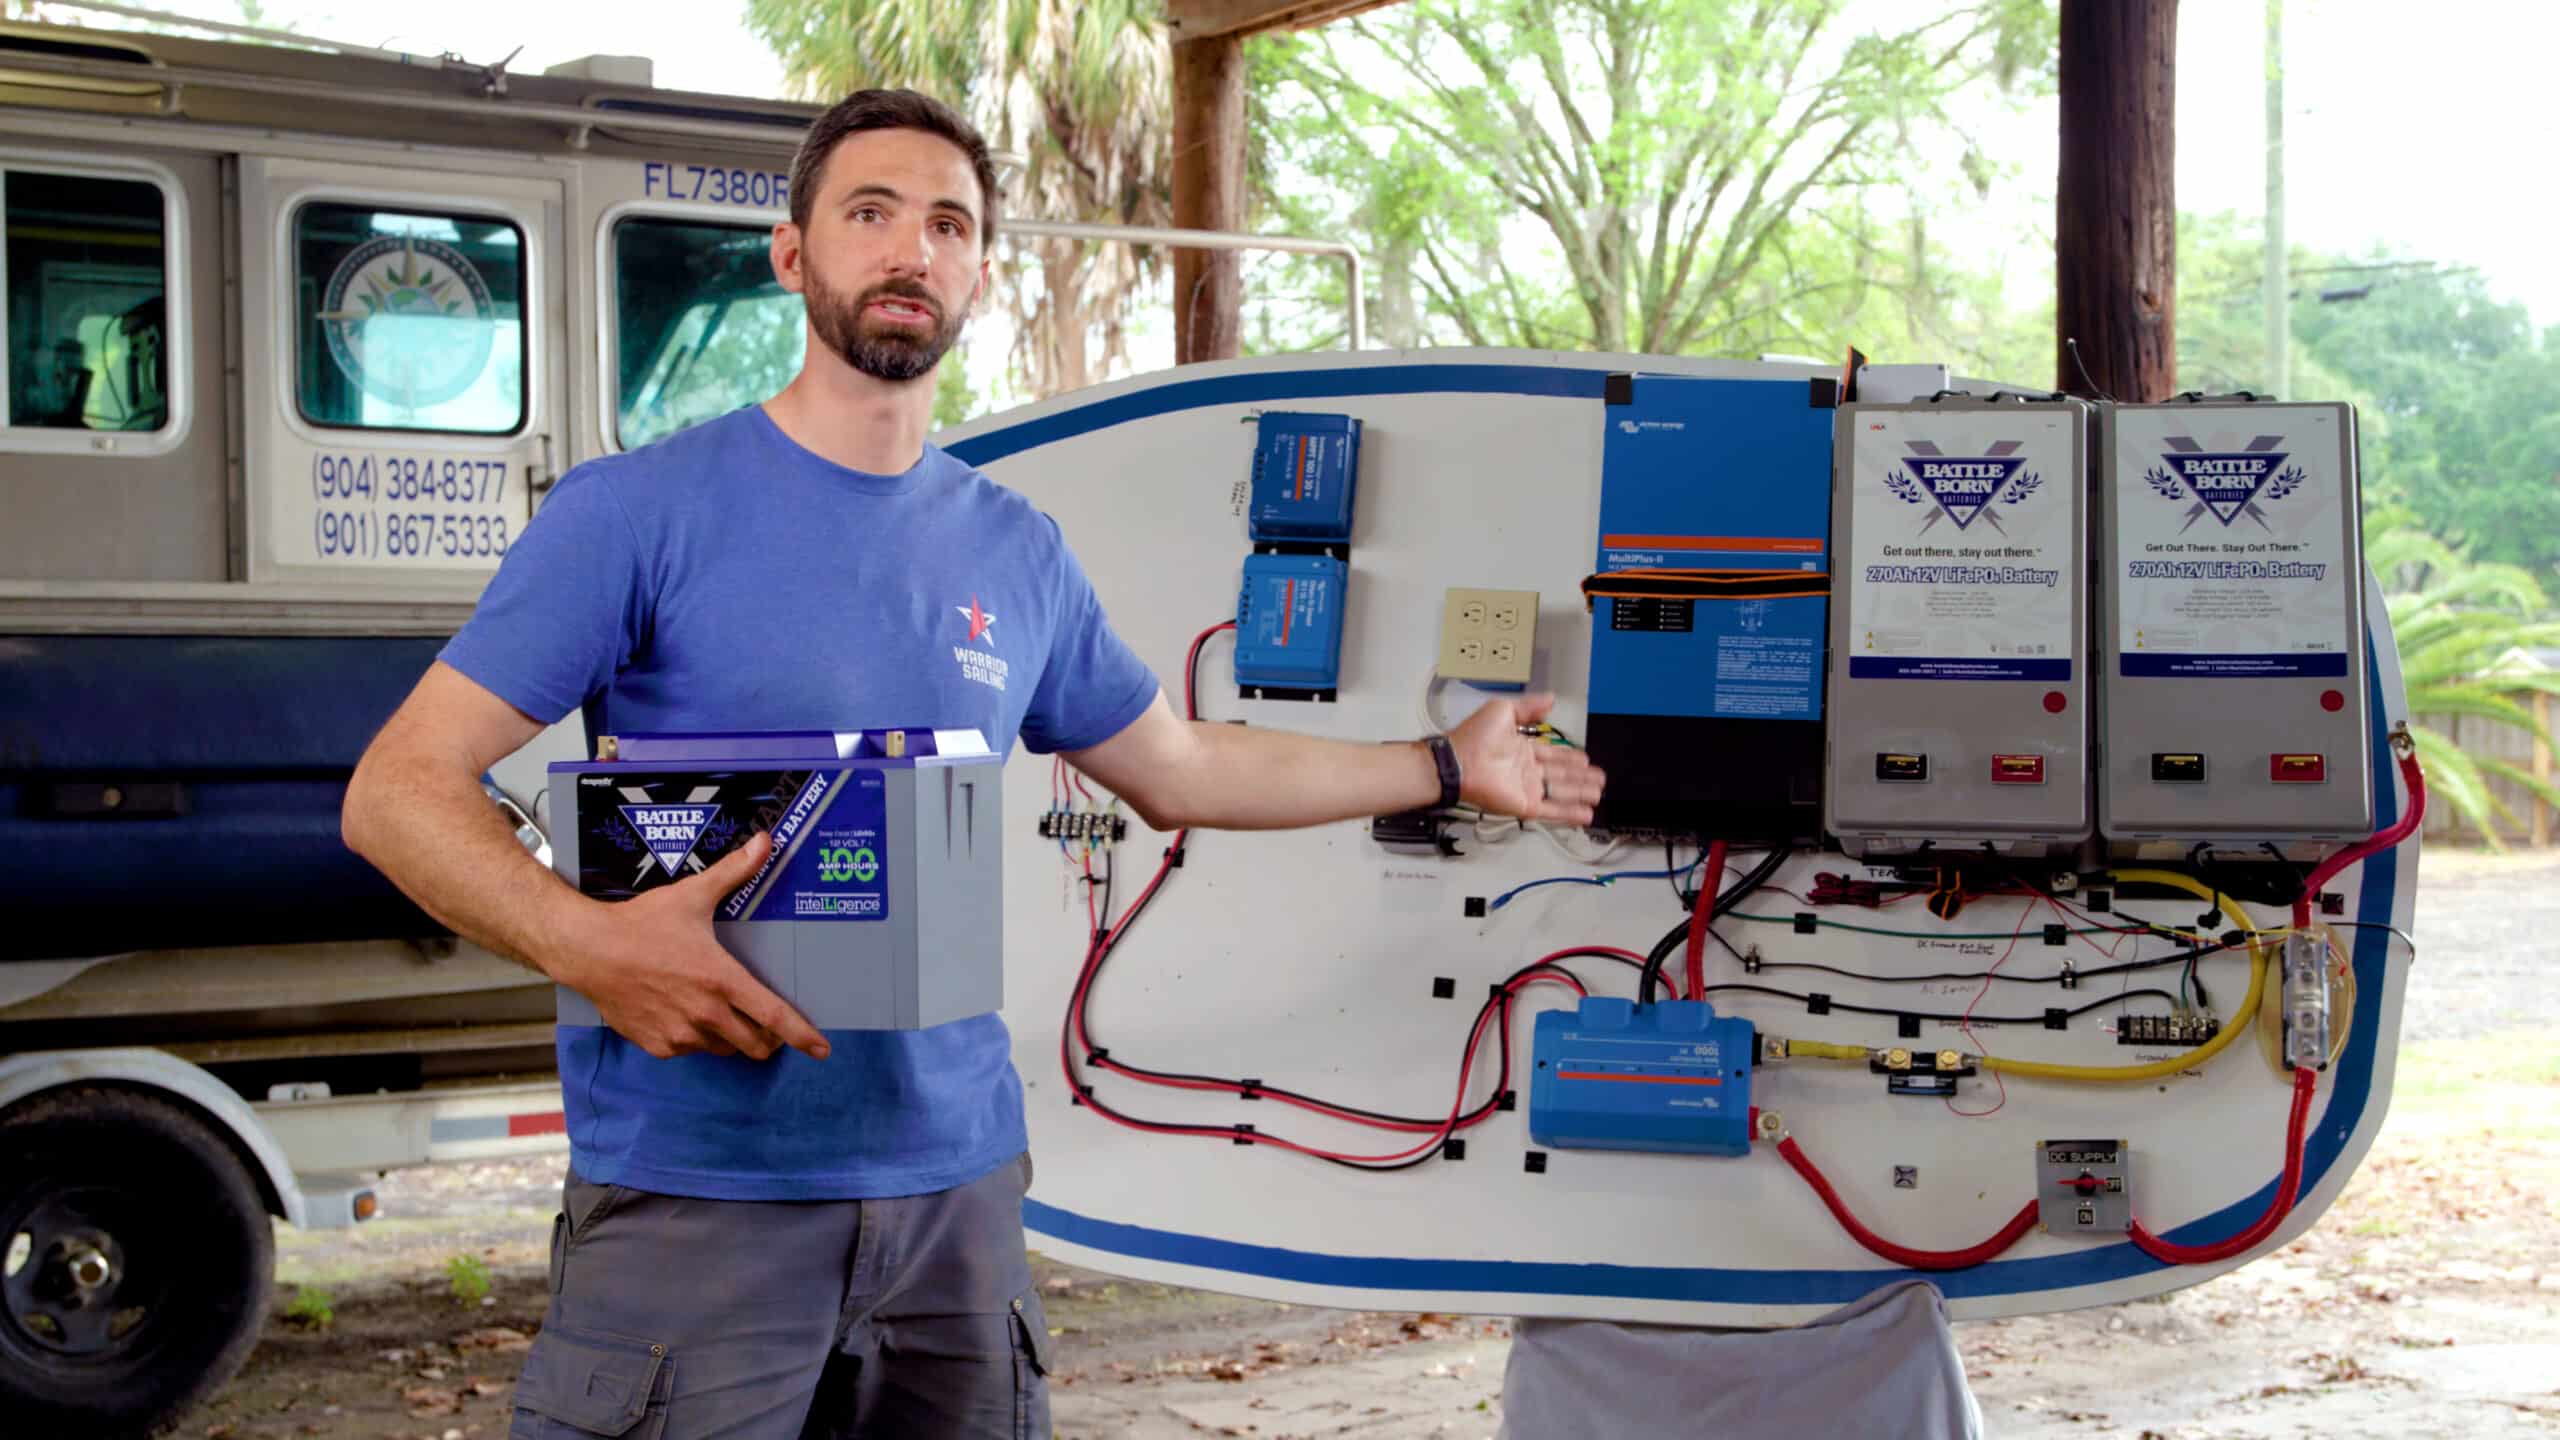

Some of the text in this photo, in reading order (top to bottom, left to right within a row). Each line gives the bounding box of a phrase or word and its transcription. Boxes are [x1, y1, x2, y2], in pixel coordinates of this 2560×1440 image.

[1923, 464, 2005, 478] BATTLE
[2183, 459, 2267, 474] BATTLE
[313, 452, 379, 504] (904)
[2195, 475, 2257, 489] BORN
[1933, 479, 1995, 494] BORN
[315, 508, 379, 558] (901)
[1883, 545, 1902, 557] Get
[1905, 547, 1922, 557] out
[1959, 547, 1981, 560] stay
[1984, 548, 2001, 558] out
[2145, 543, 2163, 553] Get
[2166, 543, 2184, 553] Out
[2222, 543, 2245, 554] Stay
[2248, 543, 2266, 553] Out
[2002, 566, 2059, 587] Battery
[2268, 561, 2326, 581] Battery
[783, 772, 829, 836] BATTERY
[634, 810, 705, 825] BATTLE
[645, 825, 696, 840] BORN
[842, 840, 866, 848] VOLT
[818, 862, 879, 870] AMP HOURS
[819, 848, 876, 882] 100
[2071, 1152, 2115, 1162] SUPPLY
